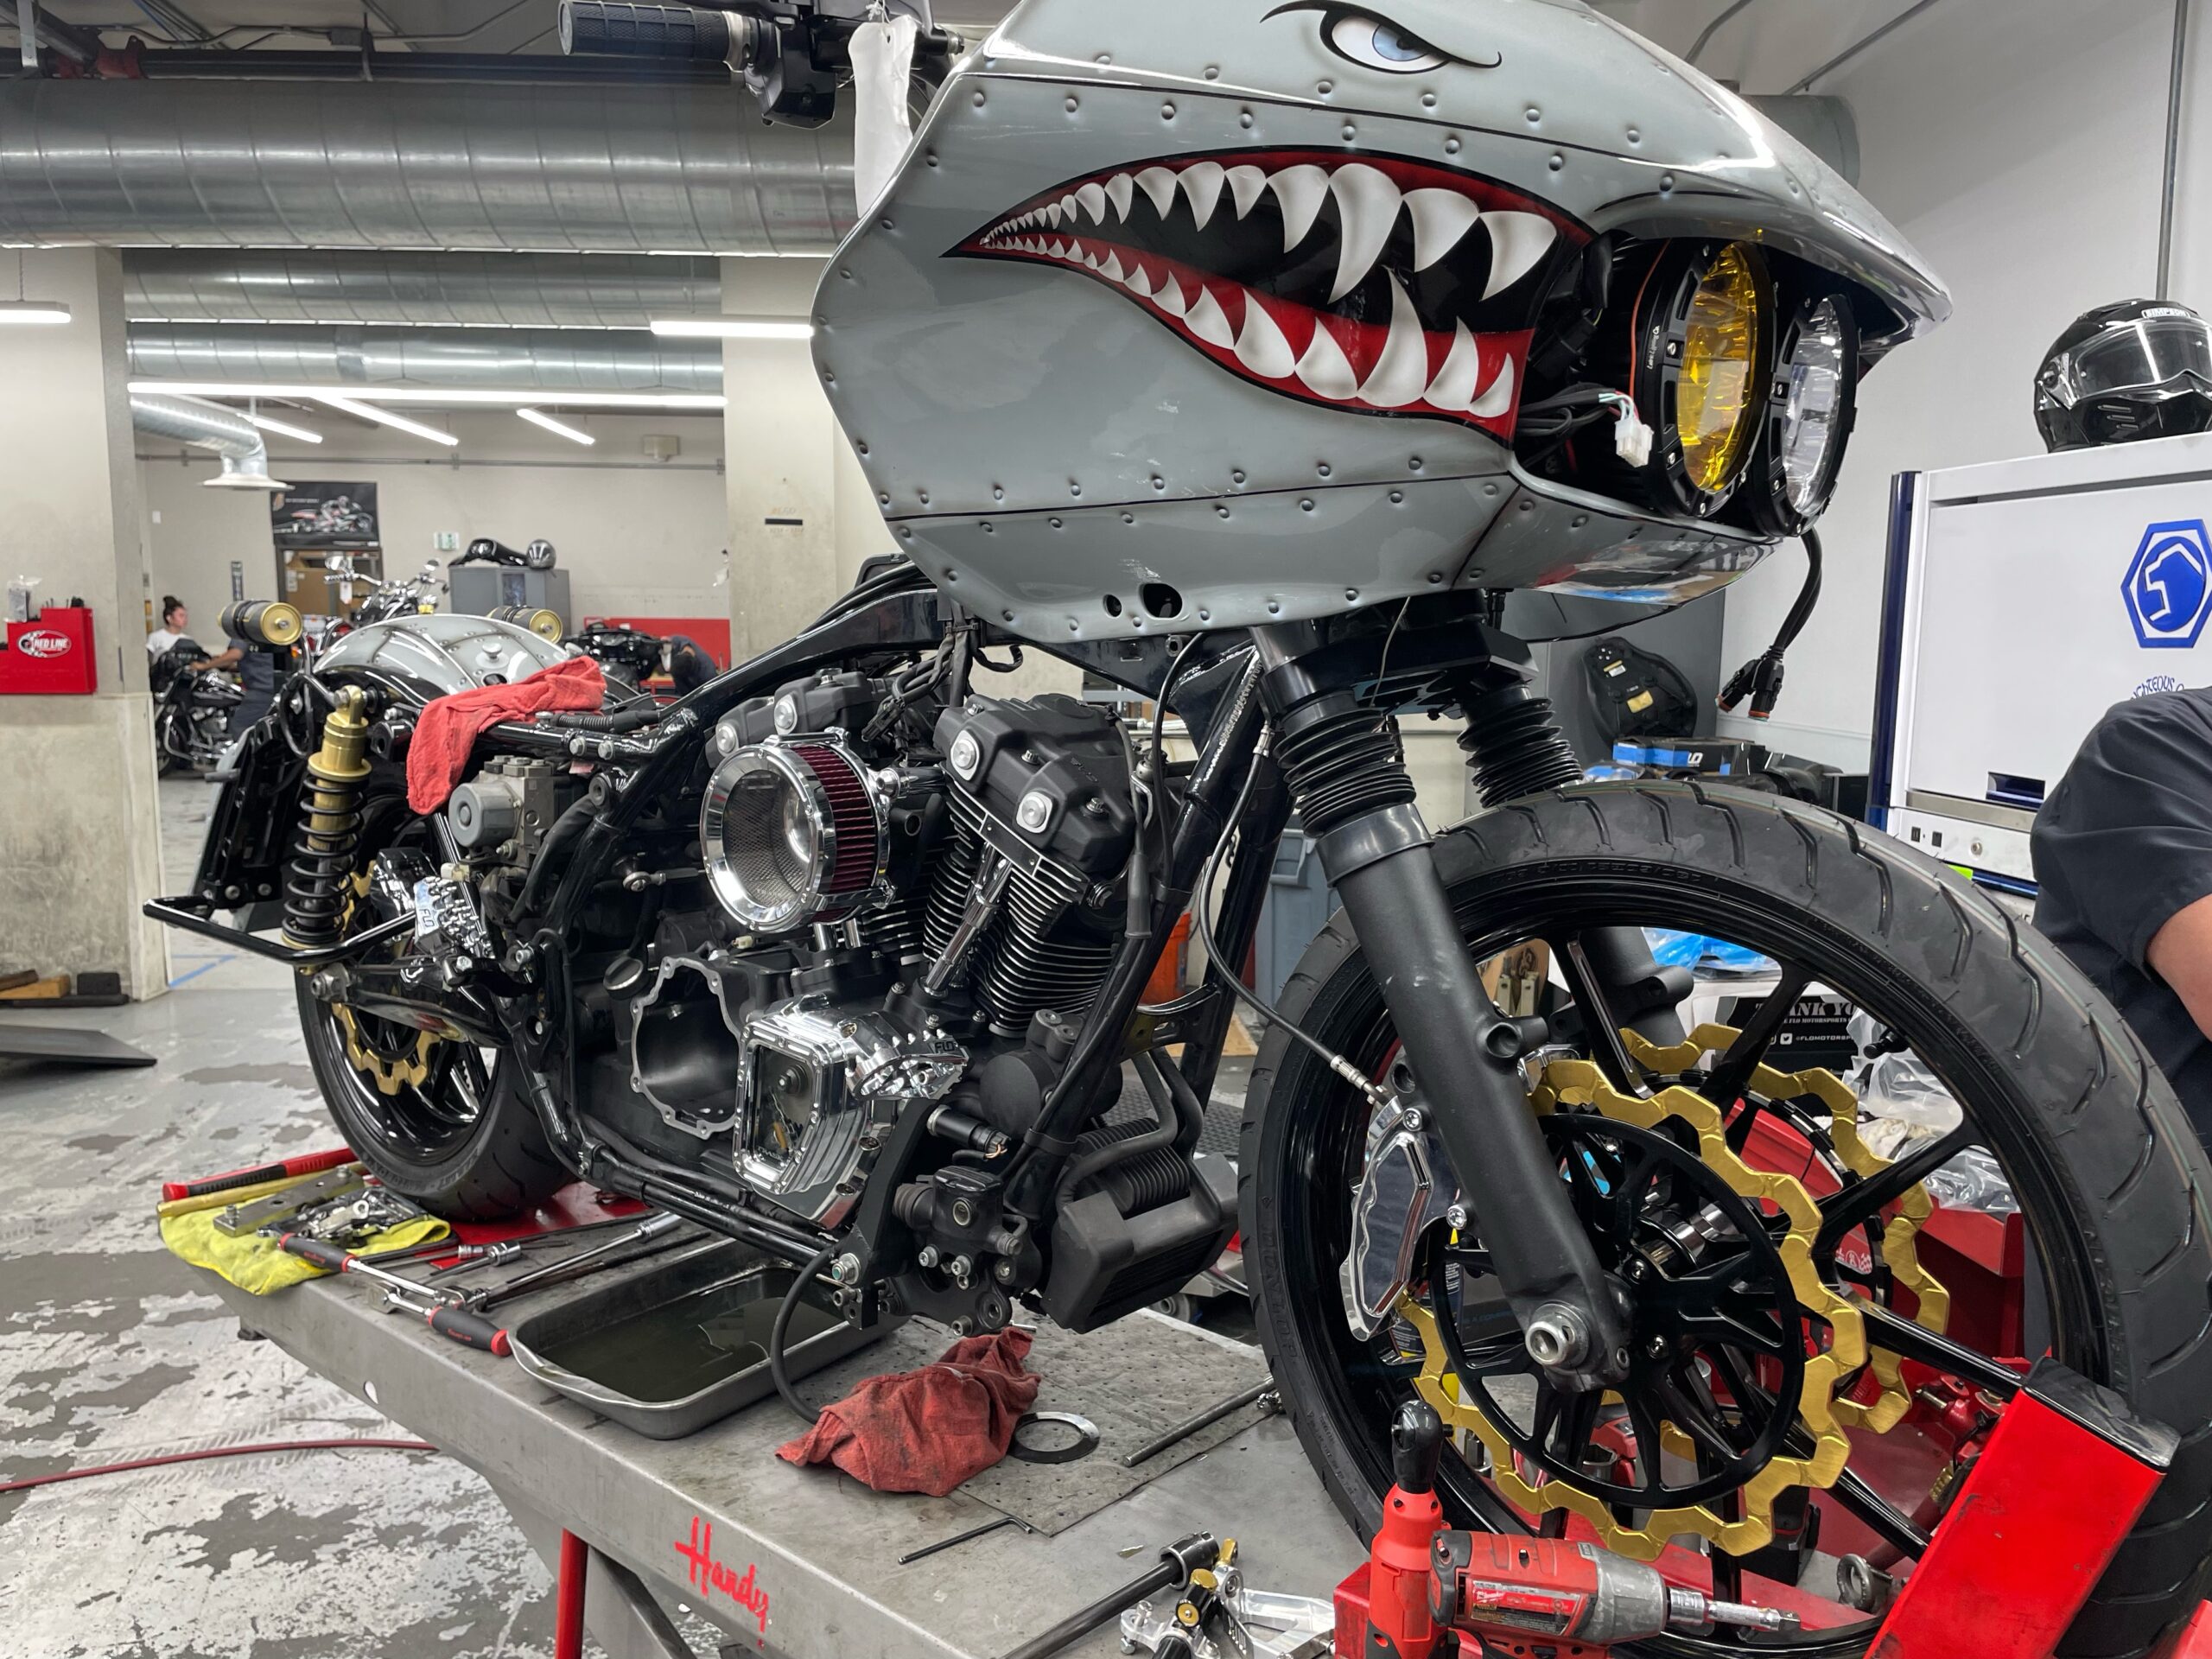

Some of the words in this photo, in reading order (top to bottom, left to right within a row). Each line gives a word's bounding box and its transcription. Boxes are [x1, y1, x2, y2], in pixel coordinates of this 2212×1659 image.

[2145, 307, 2187, 317] SIMPSON
[51, 638, 69, 650] LINE
[419, 908, 435, 927] FLO
[673, 1515, 769, 1634] Handy
